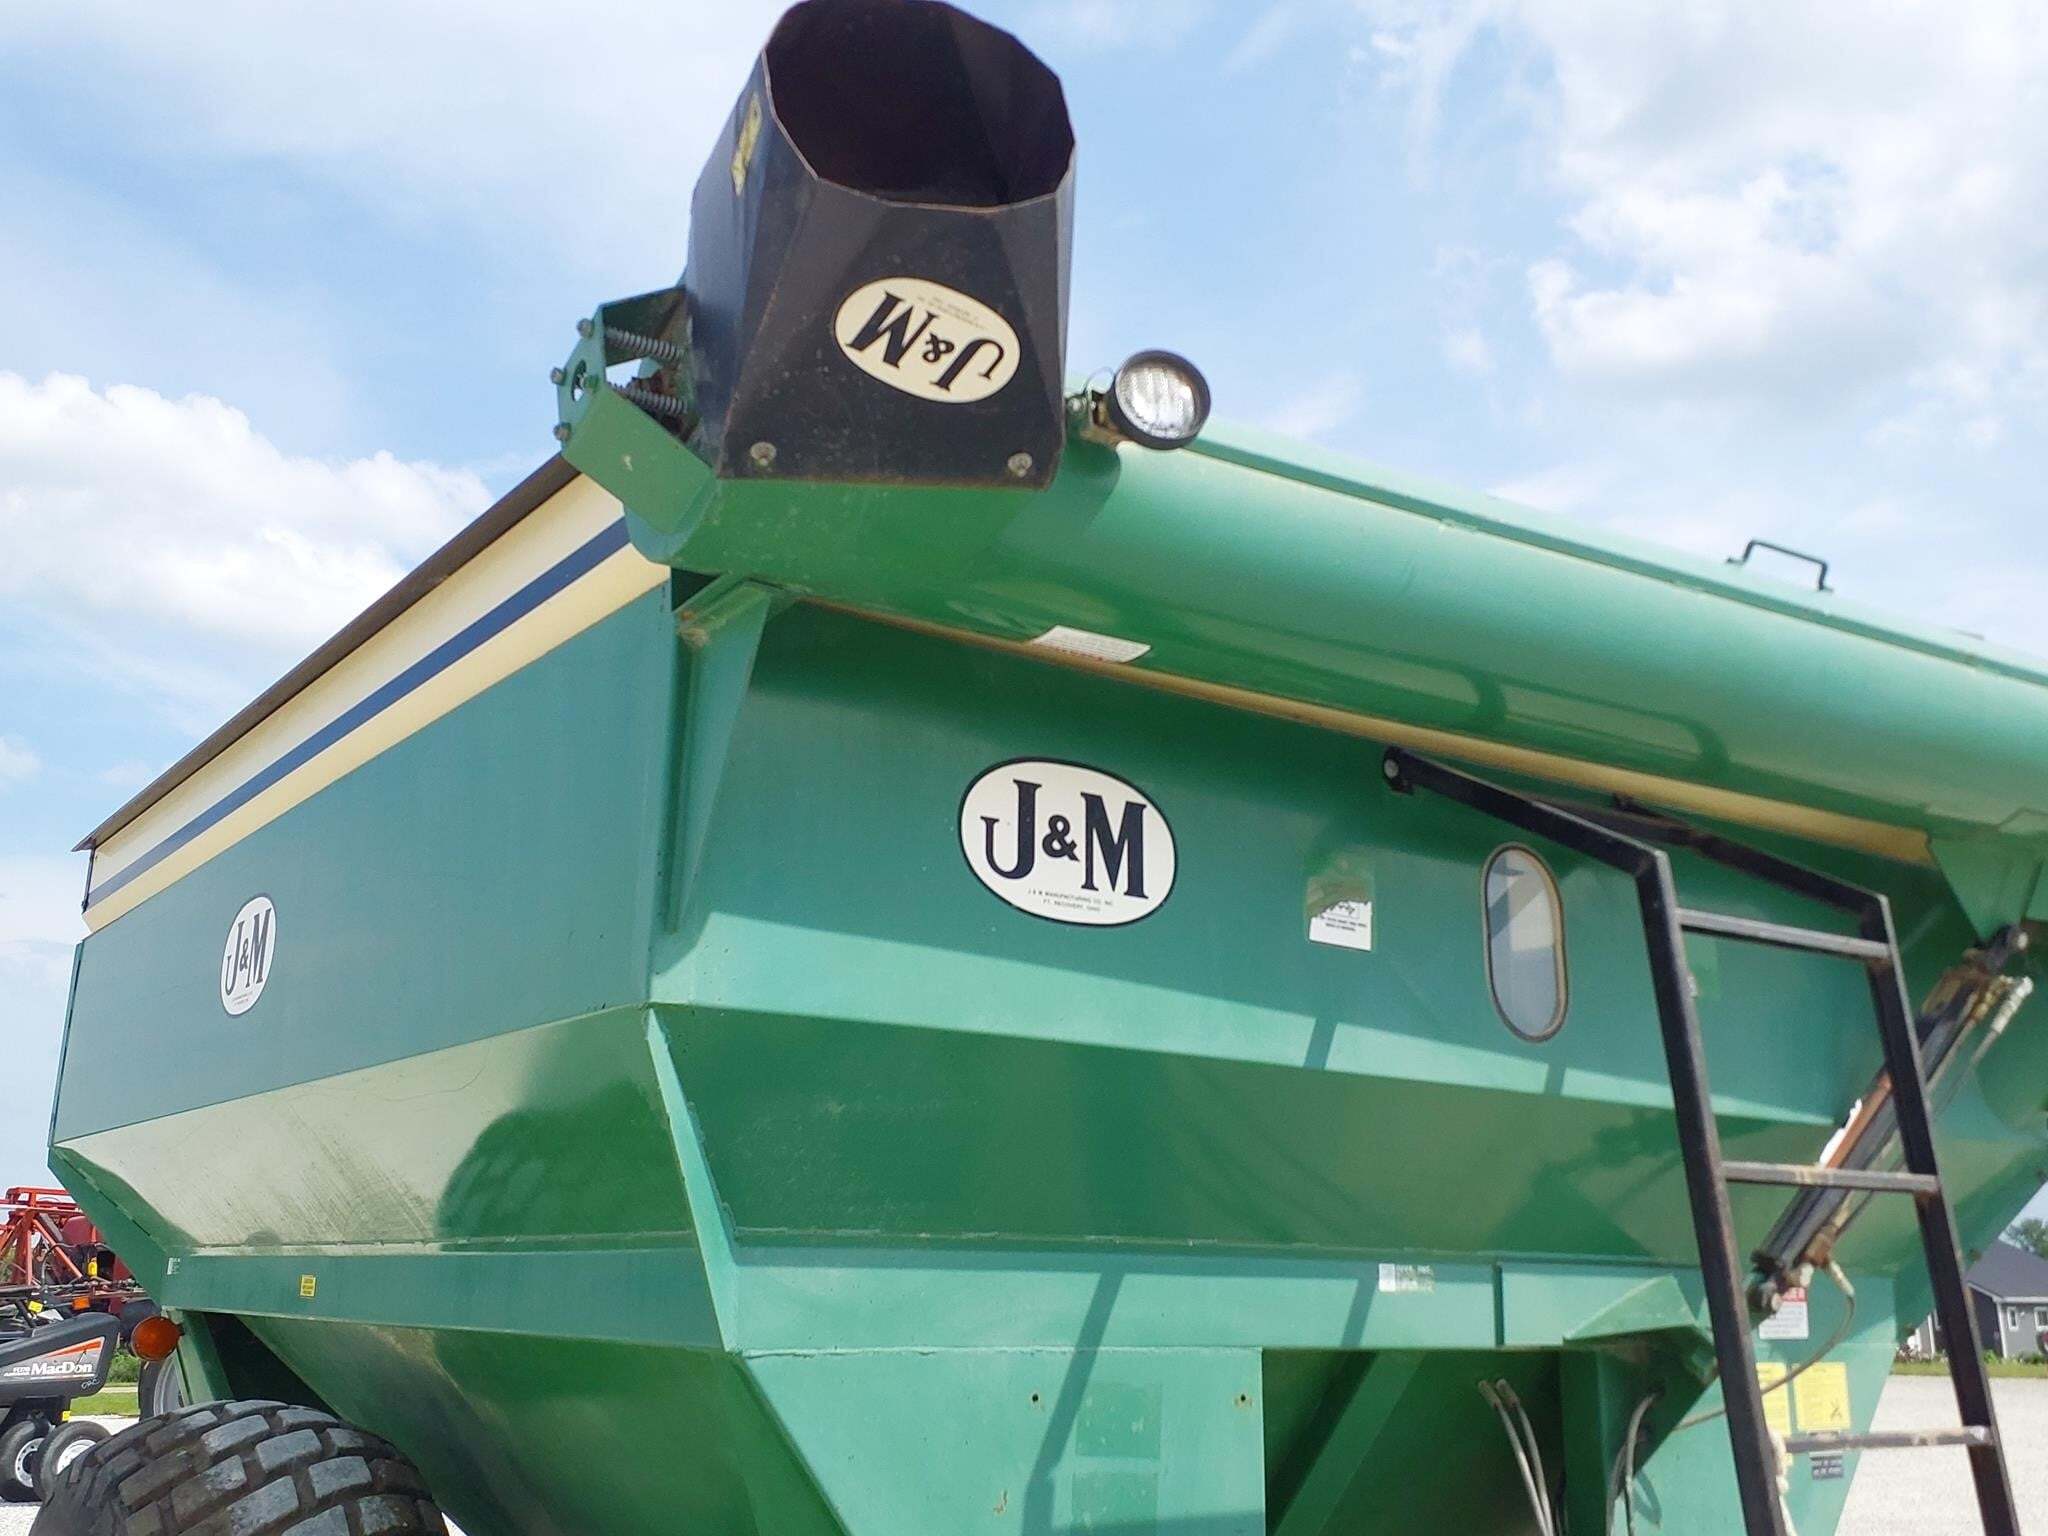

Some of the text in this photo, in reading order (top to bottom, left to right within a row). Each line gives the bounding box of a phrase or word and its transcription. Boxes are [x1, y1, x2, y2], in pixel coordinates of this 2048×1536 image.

[846, 291, 1004, 391] J&M
[980, 778, 1149, 899] J&M
[224, 908, 272, 996] J&M
[31, 1361, 93, 1375] MacDon
